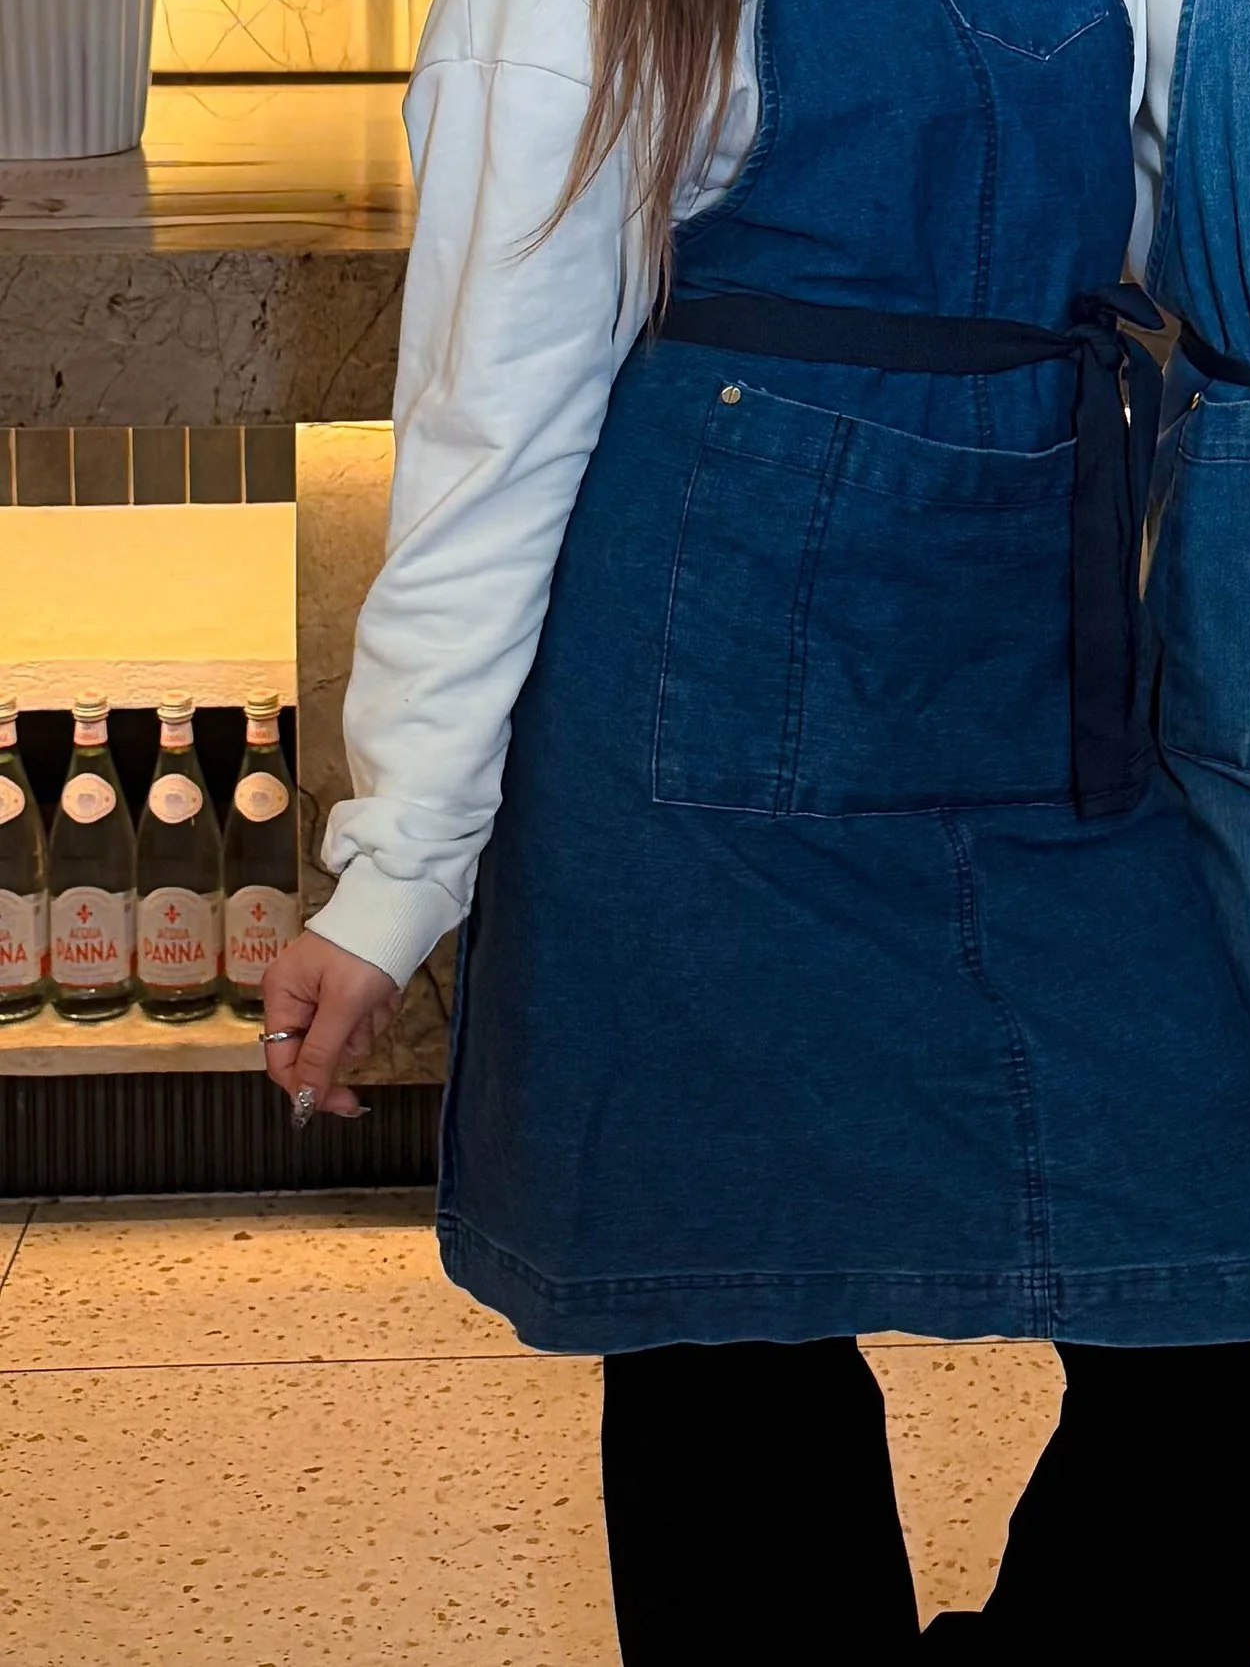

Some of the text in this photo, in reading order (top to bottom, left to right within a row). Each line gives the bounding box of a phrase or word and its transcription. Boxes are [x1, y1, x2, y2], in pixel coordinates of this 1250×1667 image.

[57, 937, 118, 964] PANNA
[143, 936, 206, 964] PANNA
[230, 936, 288, 963] PANN
